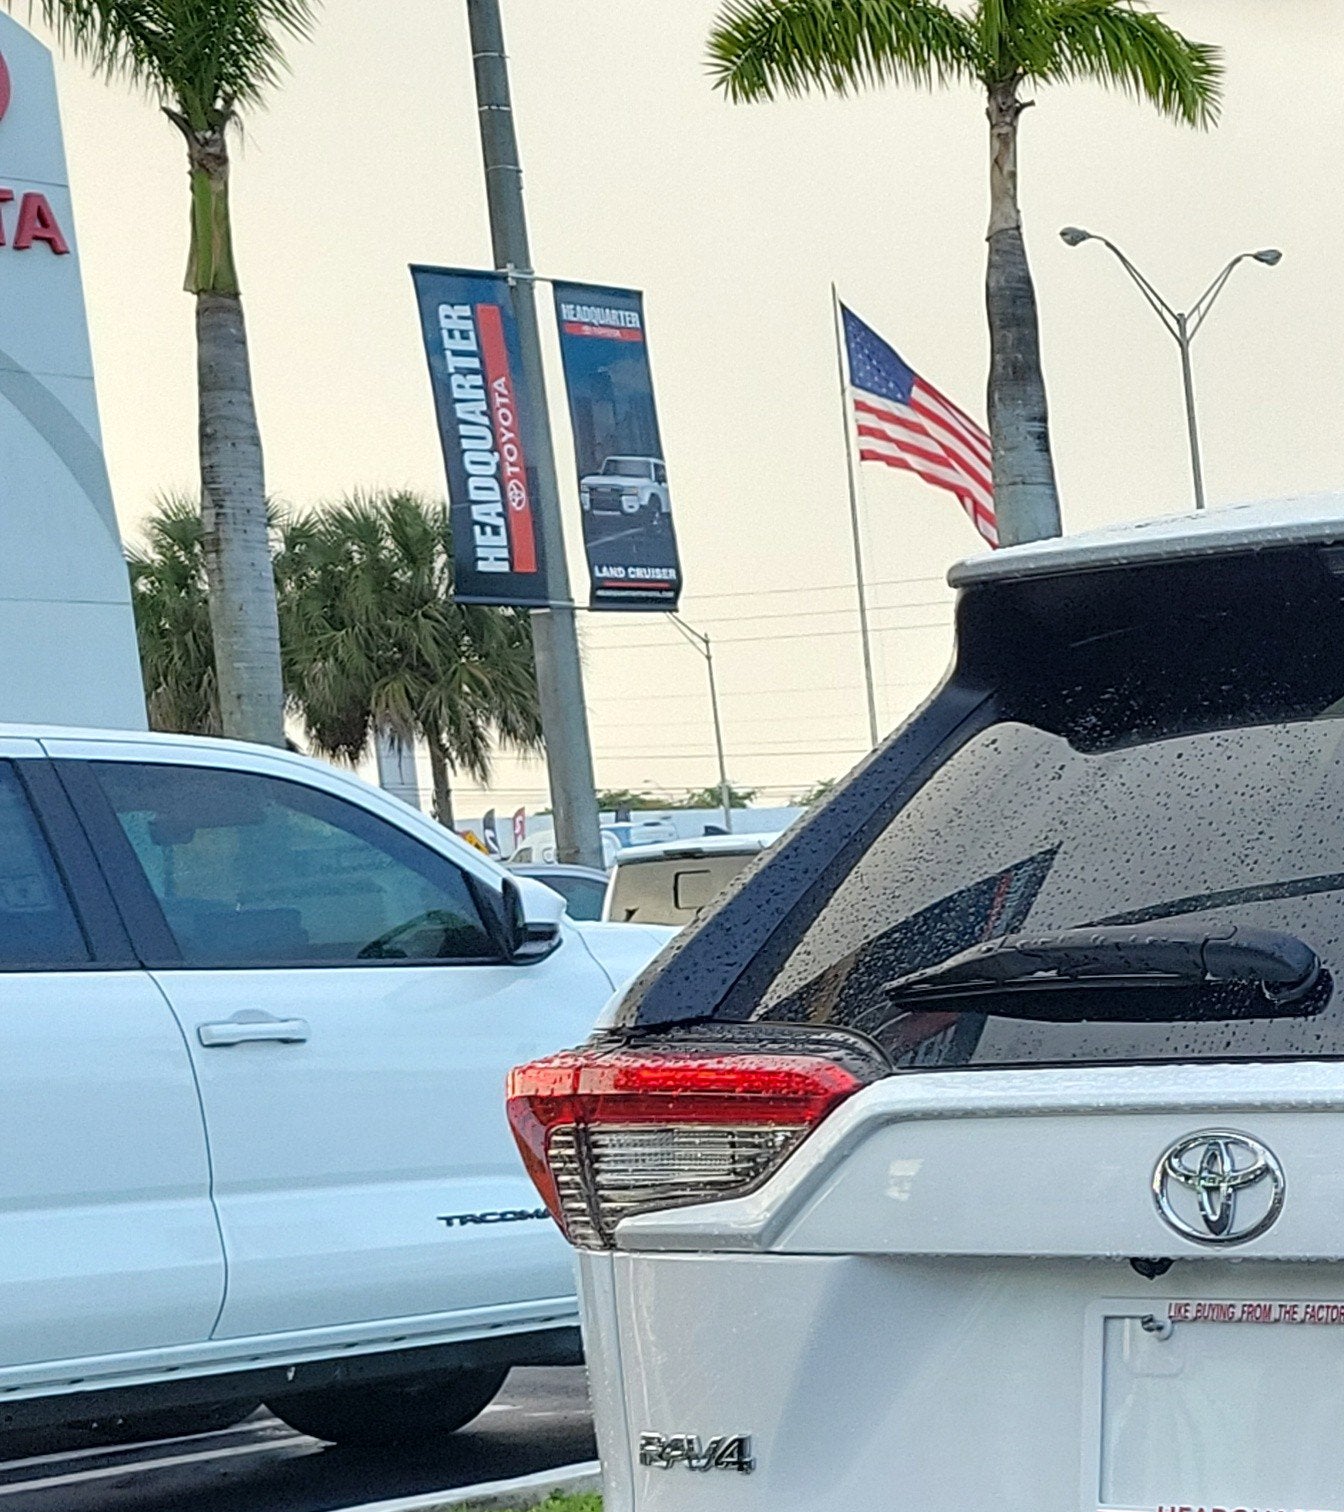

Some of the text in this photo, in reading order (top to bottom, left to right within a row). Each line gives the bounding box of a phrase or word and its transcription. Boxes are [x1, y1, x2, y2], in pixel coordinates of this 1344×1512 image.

[561, 303, 641, 328] HEADQUARTER
[438, 303, 511, 573] HEADQUARTER
[493, 376, 522, 476] TOYOTA
[594, 564, 677, 579] LAND CRUISER
[1168, 1302, 1191, 1320] LIKE
[1194, 1303, 1236, 1321] BUYING
[1240, 1303, 1273, 1321] FROM
[1277, 1304, 1299, 1321] THE
[640, 1432, 756, 1475] RAV4
